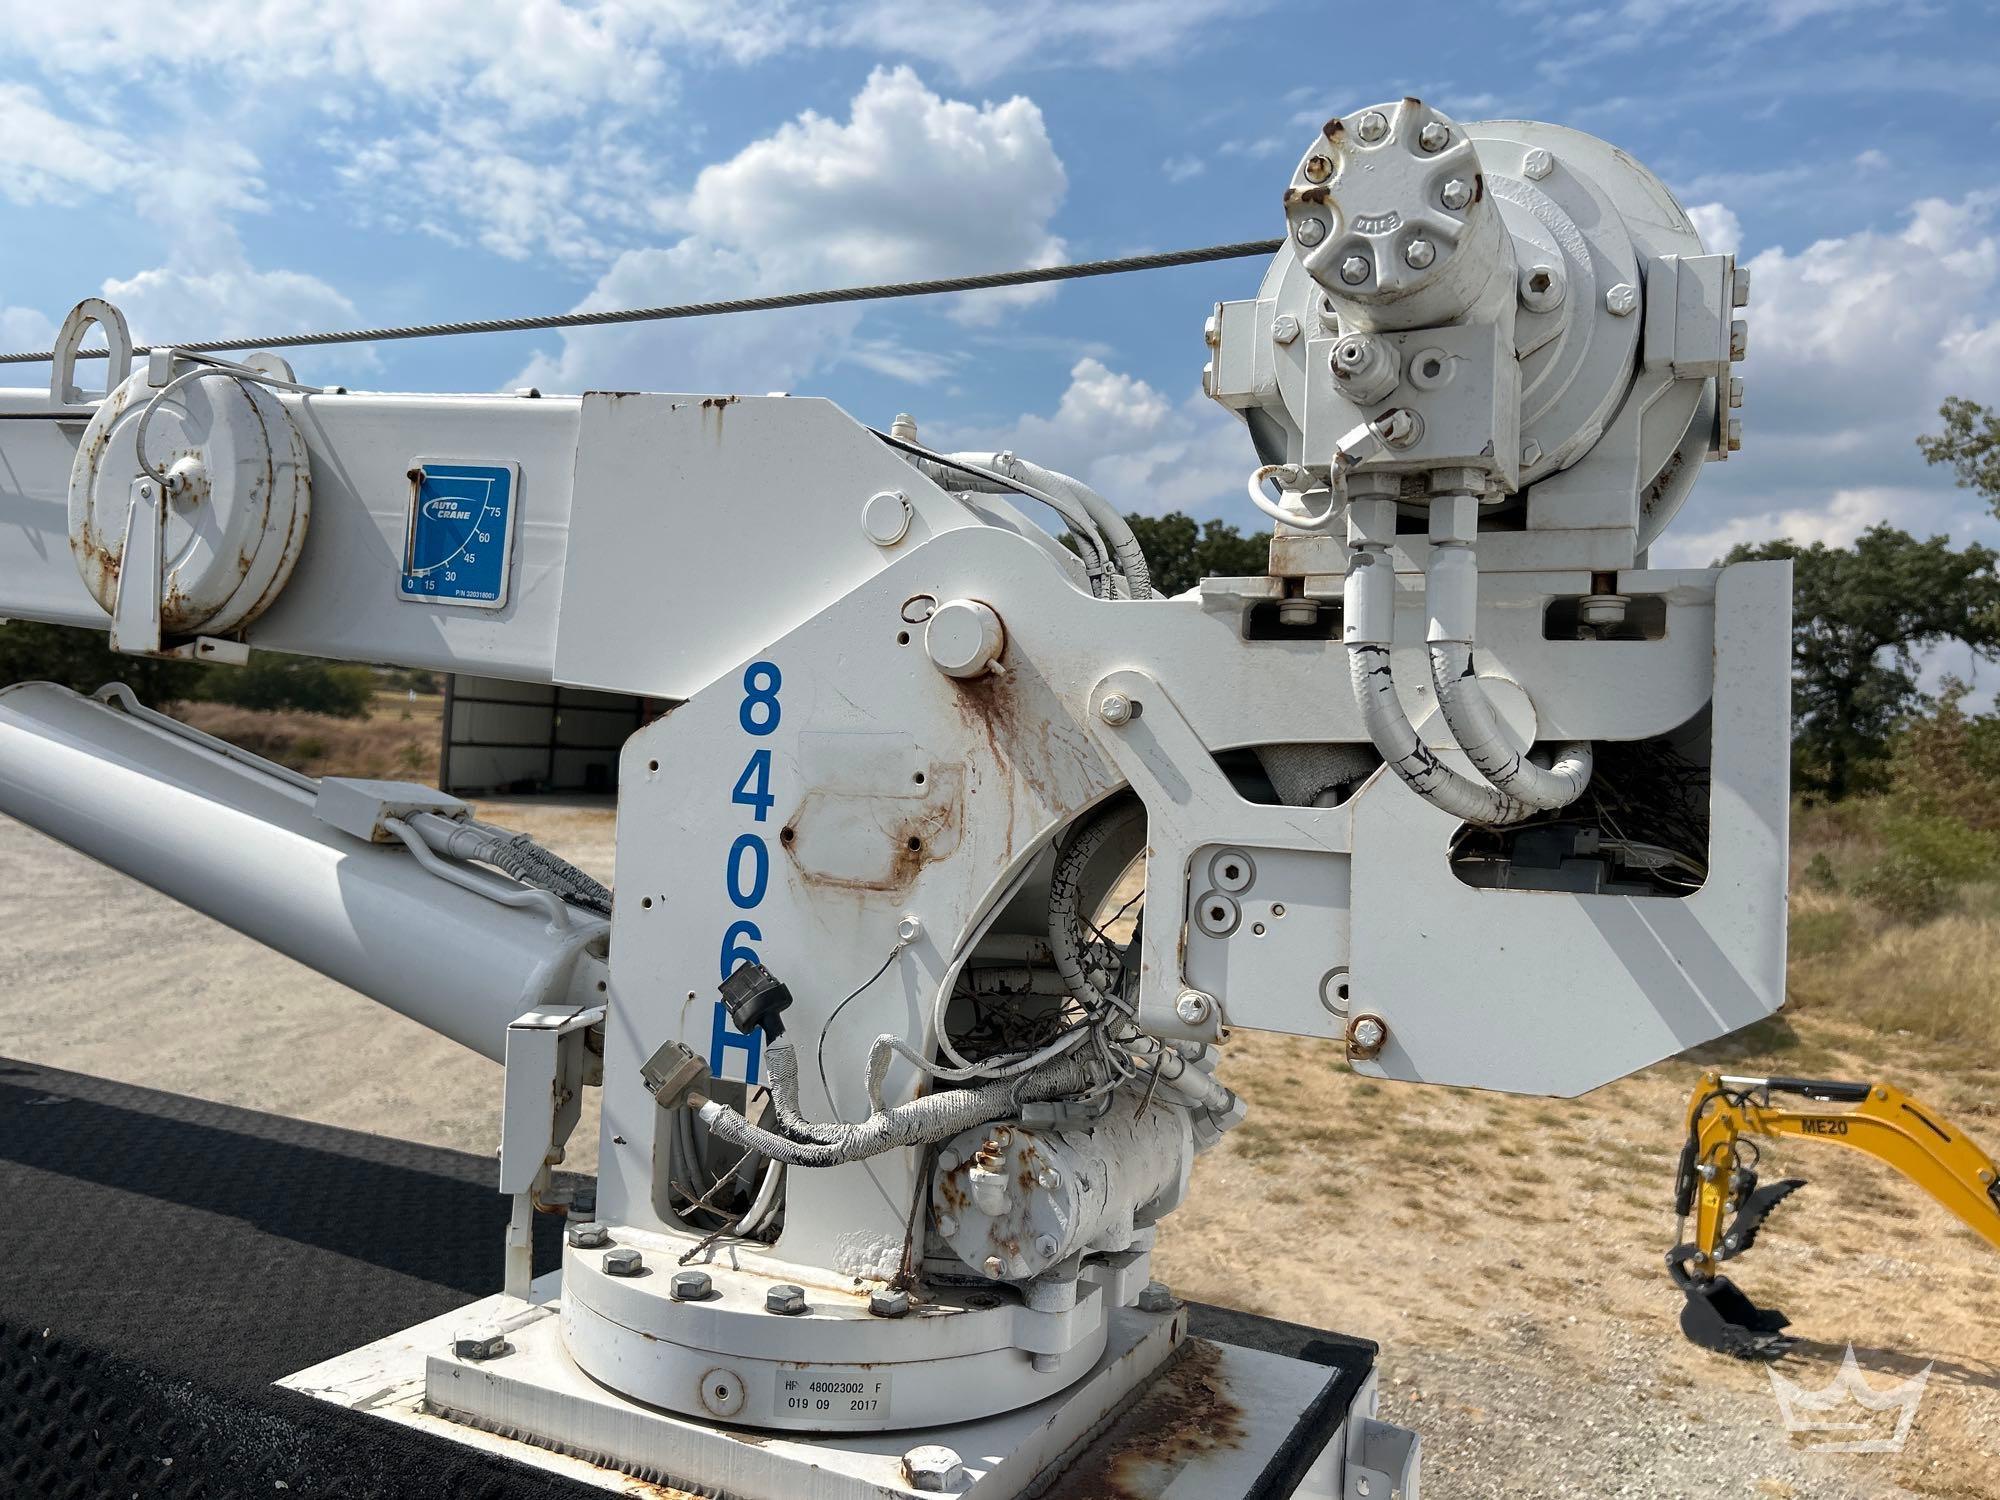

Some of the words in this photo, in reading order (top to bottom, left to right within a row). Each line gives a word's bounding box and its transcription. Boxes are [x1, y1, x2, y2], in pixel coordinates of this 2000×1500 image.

[431, 501, 458, 511] AUTO
[437, 510, 471, 520] CRANE
[489, 507, 501, 518] 75
[479, 533, 490, 543] 60
[463, 554, 476, 564] 45
[445, 571, 457, 582] 30
[407, 580, 414, 589] 0
[424, 580, 435, 590] 15
[1801, 1118, 1848, 1135] ME20
[809, 1382, 864, 1393] 480023002
[788, 1397, 809, 1409] 019
[816, 1399, 830, 1410] 09
[850, 1400, 877, 1411] 2017
